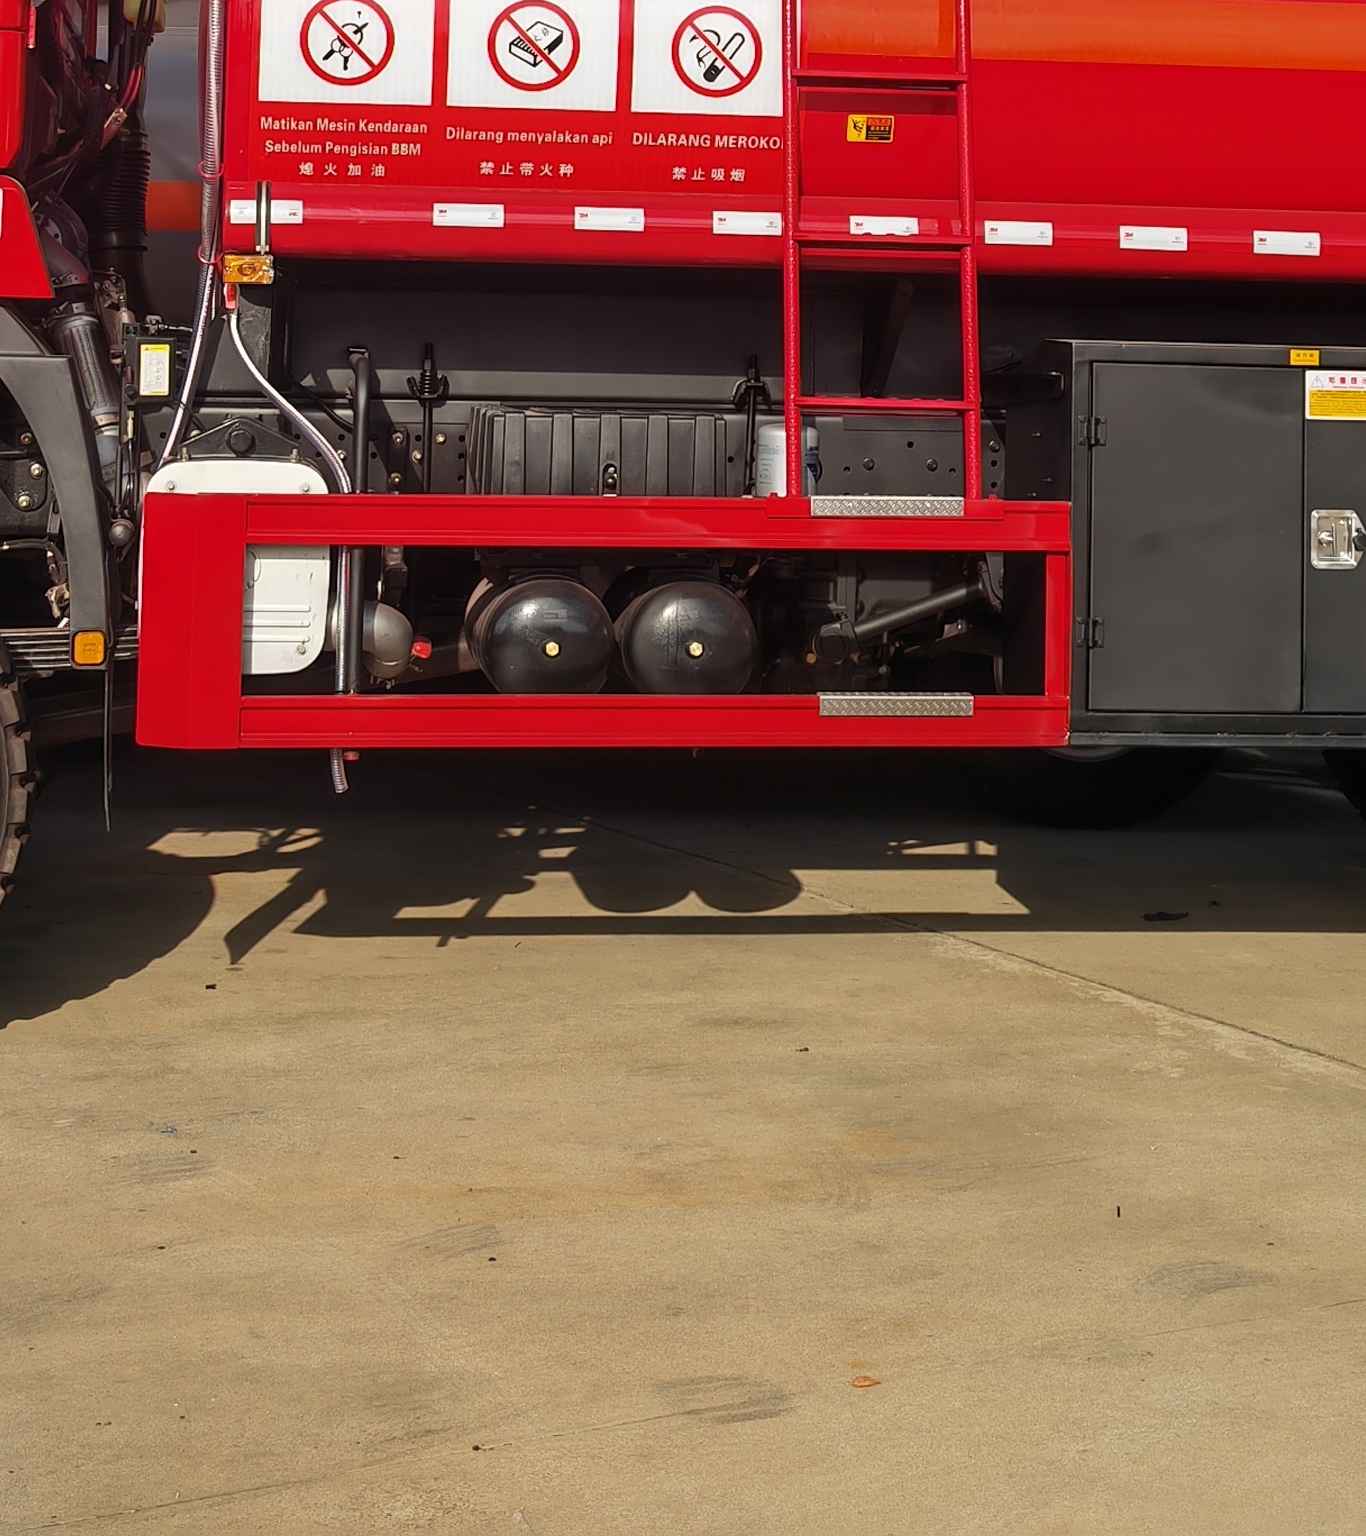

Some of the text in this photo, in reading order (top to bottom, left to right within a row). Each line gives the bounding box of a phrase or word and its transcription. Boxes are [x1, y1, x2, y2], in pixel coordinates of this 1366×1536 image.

[260, 116, 428, 134] Matikan Mesin Kendaraan
[445, 126, 613, 147] Dilarang menyalakan api
[632, 132, 784, 150] DILARANG MEROKO
[265, 140, 421, 157] Sebelum Pengisian BBM
[299, 162, 385, 177] 熄火加油
[479, 161, 574, 177] 禁止带火种
[671, 166, 745, 182] 禁止吸烟
